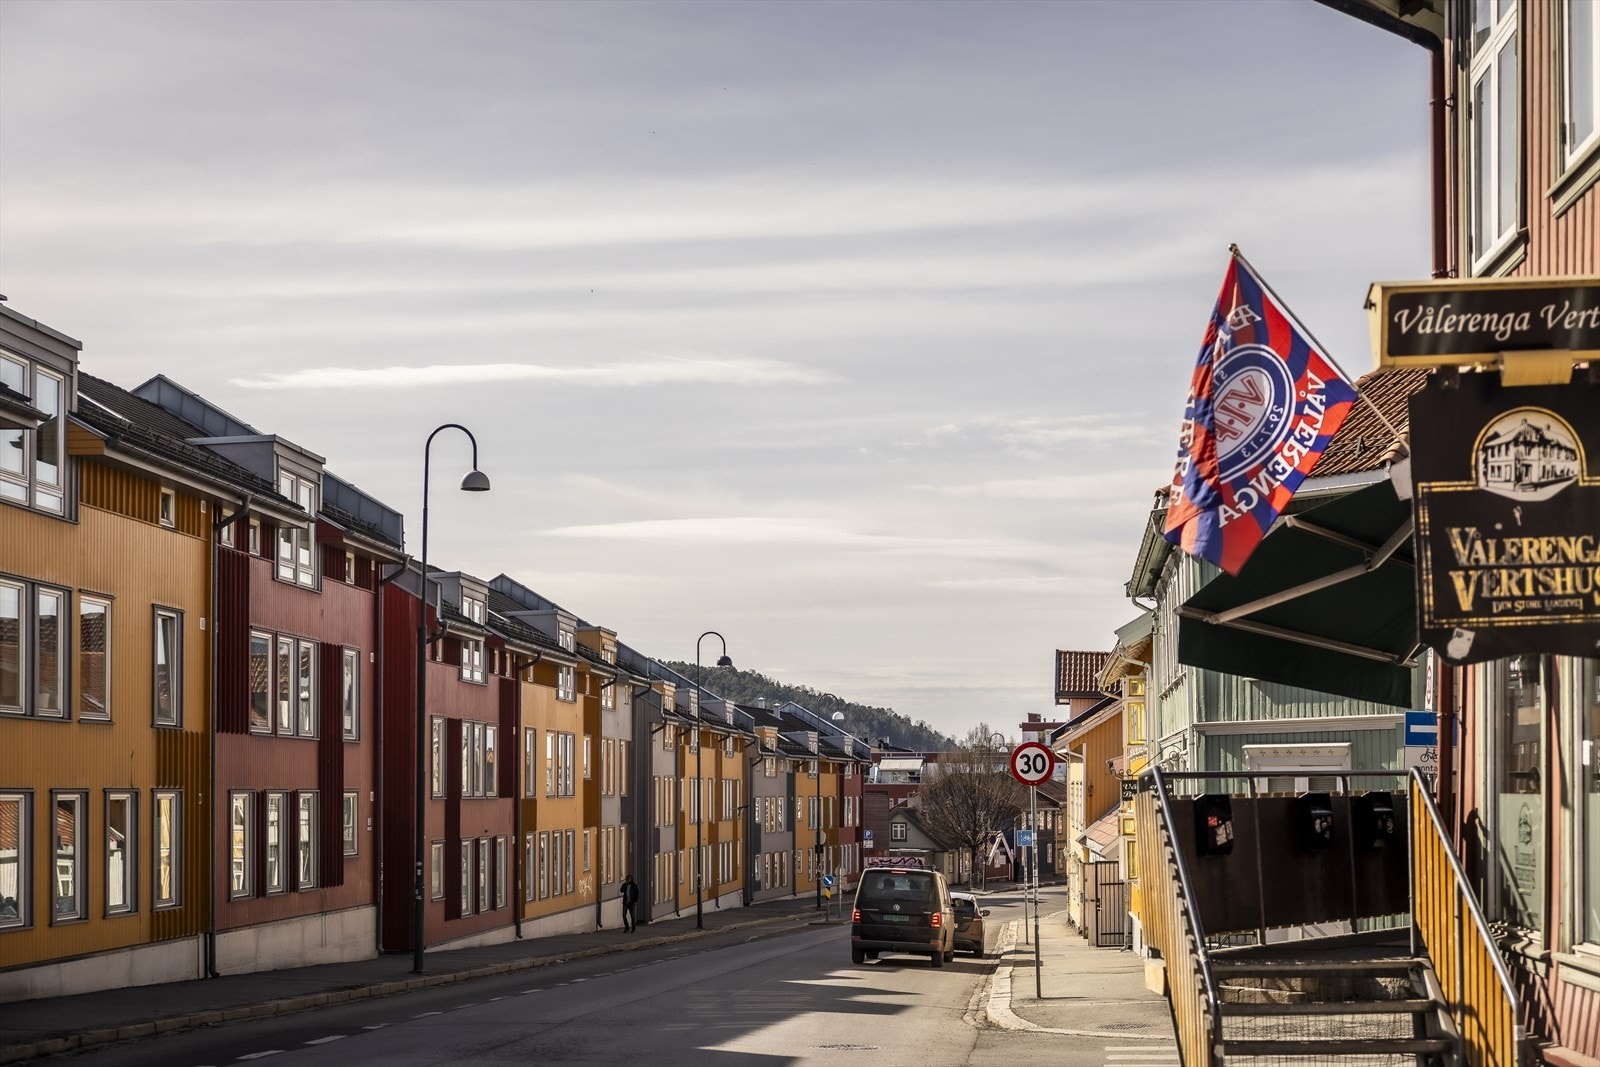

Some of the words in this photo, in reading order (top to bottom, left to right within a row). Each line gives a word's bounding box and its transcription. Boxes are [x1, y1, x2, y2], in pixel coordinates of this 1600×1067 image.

[1394, 304, 1531, 341] Vålerenga
[1492, 601, 1512, 613] DEN
[1019, 753, 1046, 774] 30
